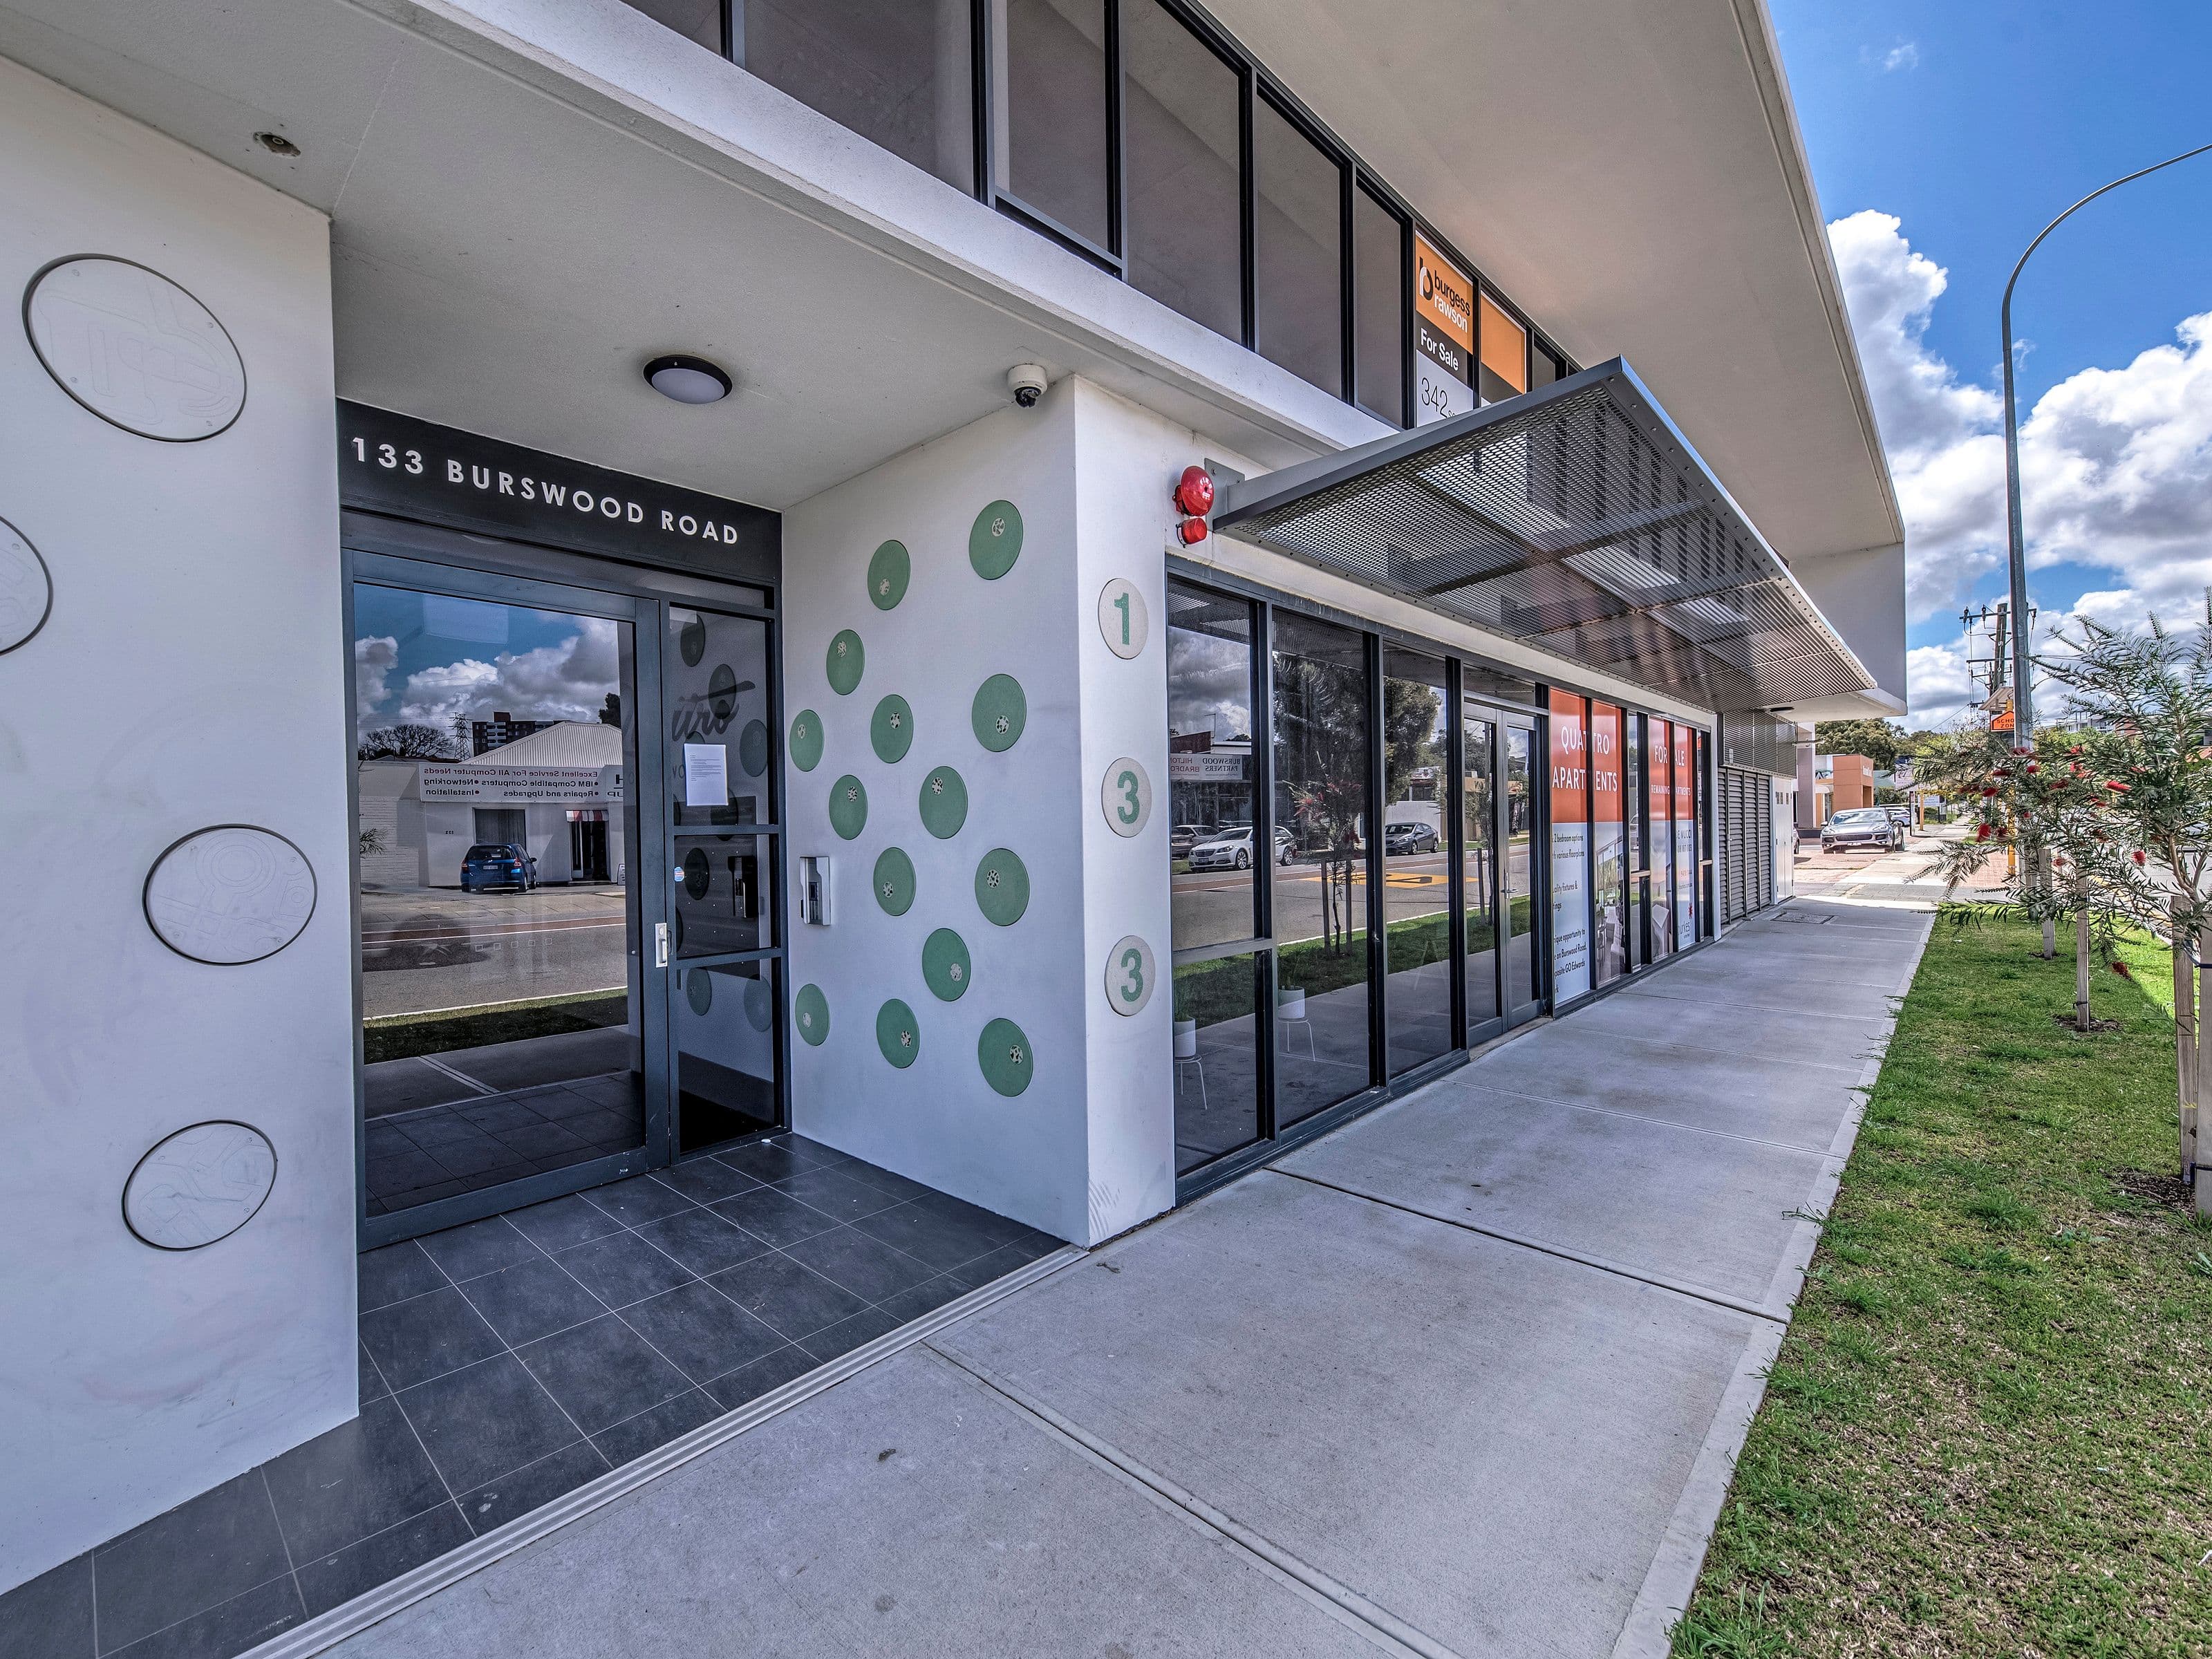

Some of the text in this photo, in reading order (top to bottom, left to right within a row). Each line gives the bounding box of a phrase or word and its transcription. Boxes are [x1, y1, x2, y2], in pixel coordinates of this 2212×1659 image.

[1434, 270, 1470, 316] burgess
[1434, 293, 1468, 332] rawson
[1421, 327, 1459, 371] For Sale
[1421, 377, 1448, 419] 342
[350, 437, 738, 545] 133 BURSWOOD ROAD
[1114, 592, 1130, 646] 1
[1654, 745, 1685, 767] FOR ALE
[1553, 766, 1618, 792] APARTENTS
[1117, 770, 1139, 825] 3
[1557, 833, 1571, 843] bedroom
[1572, 834, 1584, 844] options
[1557, 850, 1569, 859] various
[1569, 848, 1585, 860] floorplans
[1553, 883, 1562, 894] ality
[1562, 882, 1575, 892] fixtures
[1562, 944, 1577, 958] Burswood
[1563, 929, 1582, 943] opportunity
[1121, 948, 1143, 1003] 3
[1565, 962, 1572, 974] GO
[1572, 958, 1586, 970] Edwards
